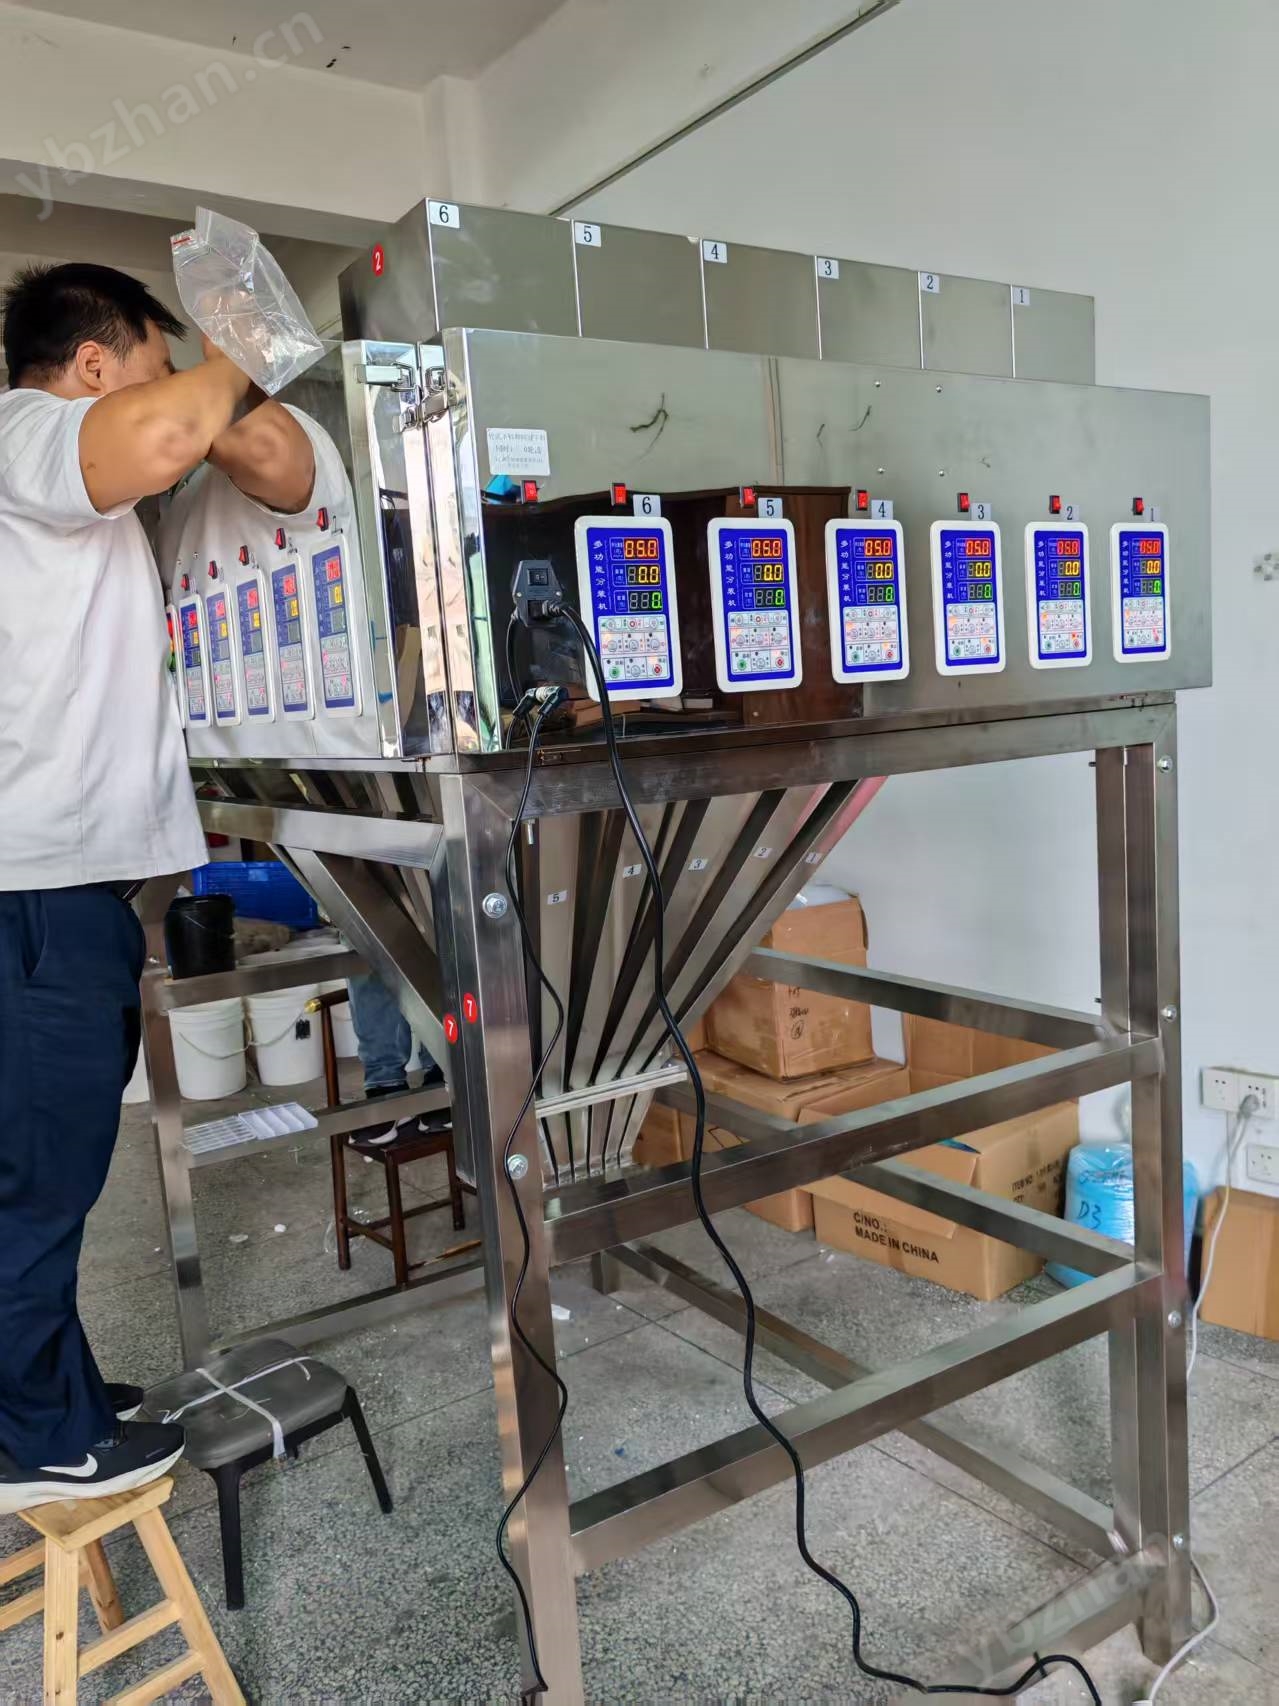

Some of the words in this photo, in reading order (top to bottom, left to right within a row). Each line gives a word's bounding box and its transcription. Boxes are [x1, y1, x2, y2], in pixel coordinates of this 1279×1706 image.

[438, 204, 450, 224] 6
[583, 225, 593, 243] 5
[710, 243, 720, 260] 4
[375, 251, 382, 271] 2
[824, 260, 833, 276] 3
[926, 275, 935, 290] 2
[1019, 289, 1025, 303] 1
[642, 496, 652, 514] 6
[766, 499, 775, 516] 5
[878, 501, 887, 517] 4
[977, 504, 985, 520] 3
[1066, 506, 1073, 520] 2
[552, 893, 560, 903] 5
[467, 1000, 473, 1016] 7
[448, 1020, 454, 1037] 7
[1077, 1200, 1102, 1230] D3
[855, 1225, 887, 1246] MADE
[888, 1237, 900, 1250] IN
[902, 1241, 939, 1263] CHINA
